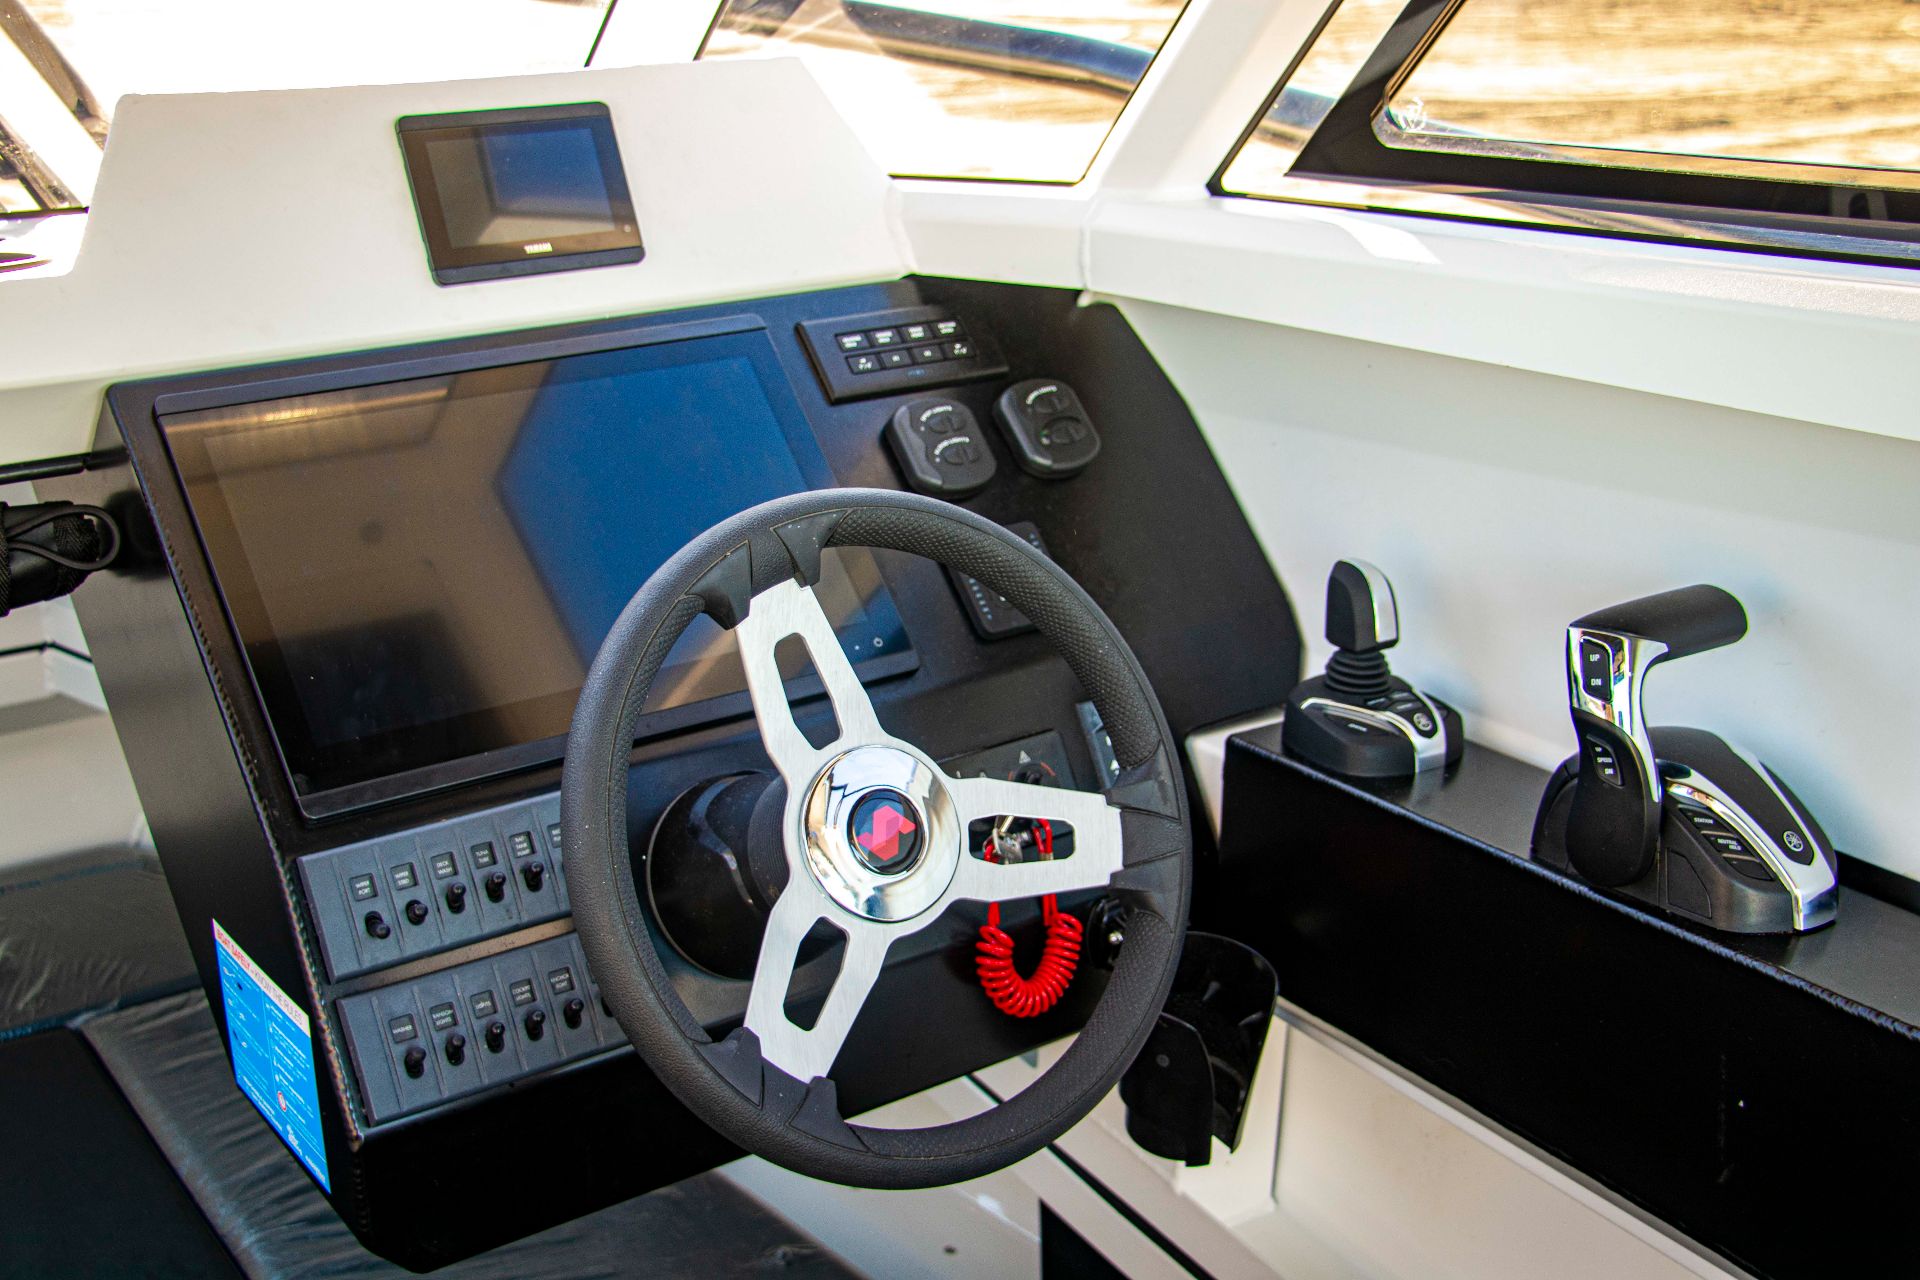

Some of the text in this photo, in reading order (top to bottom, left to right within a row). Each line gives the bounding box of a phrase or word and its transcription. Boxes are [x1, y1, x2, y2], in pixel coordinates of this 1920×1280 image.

[1589, 654, 1600, 662] UP
[1590, 678, 1602, 686] DN
[1693, 816, 1714, 825] STATION
[1717, 838, 1738, 846] NEUTRAL
[438, 866, 453, 876] WASH
[358, 887, 371, 896] PORT
